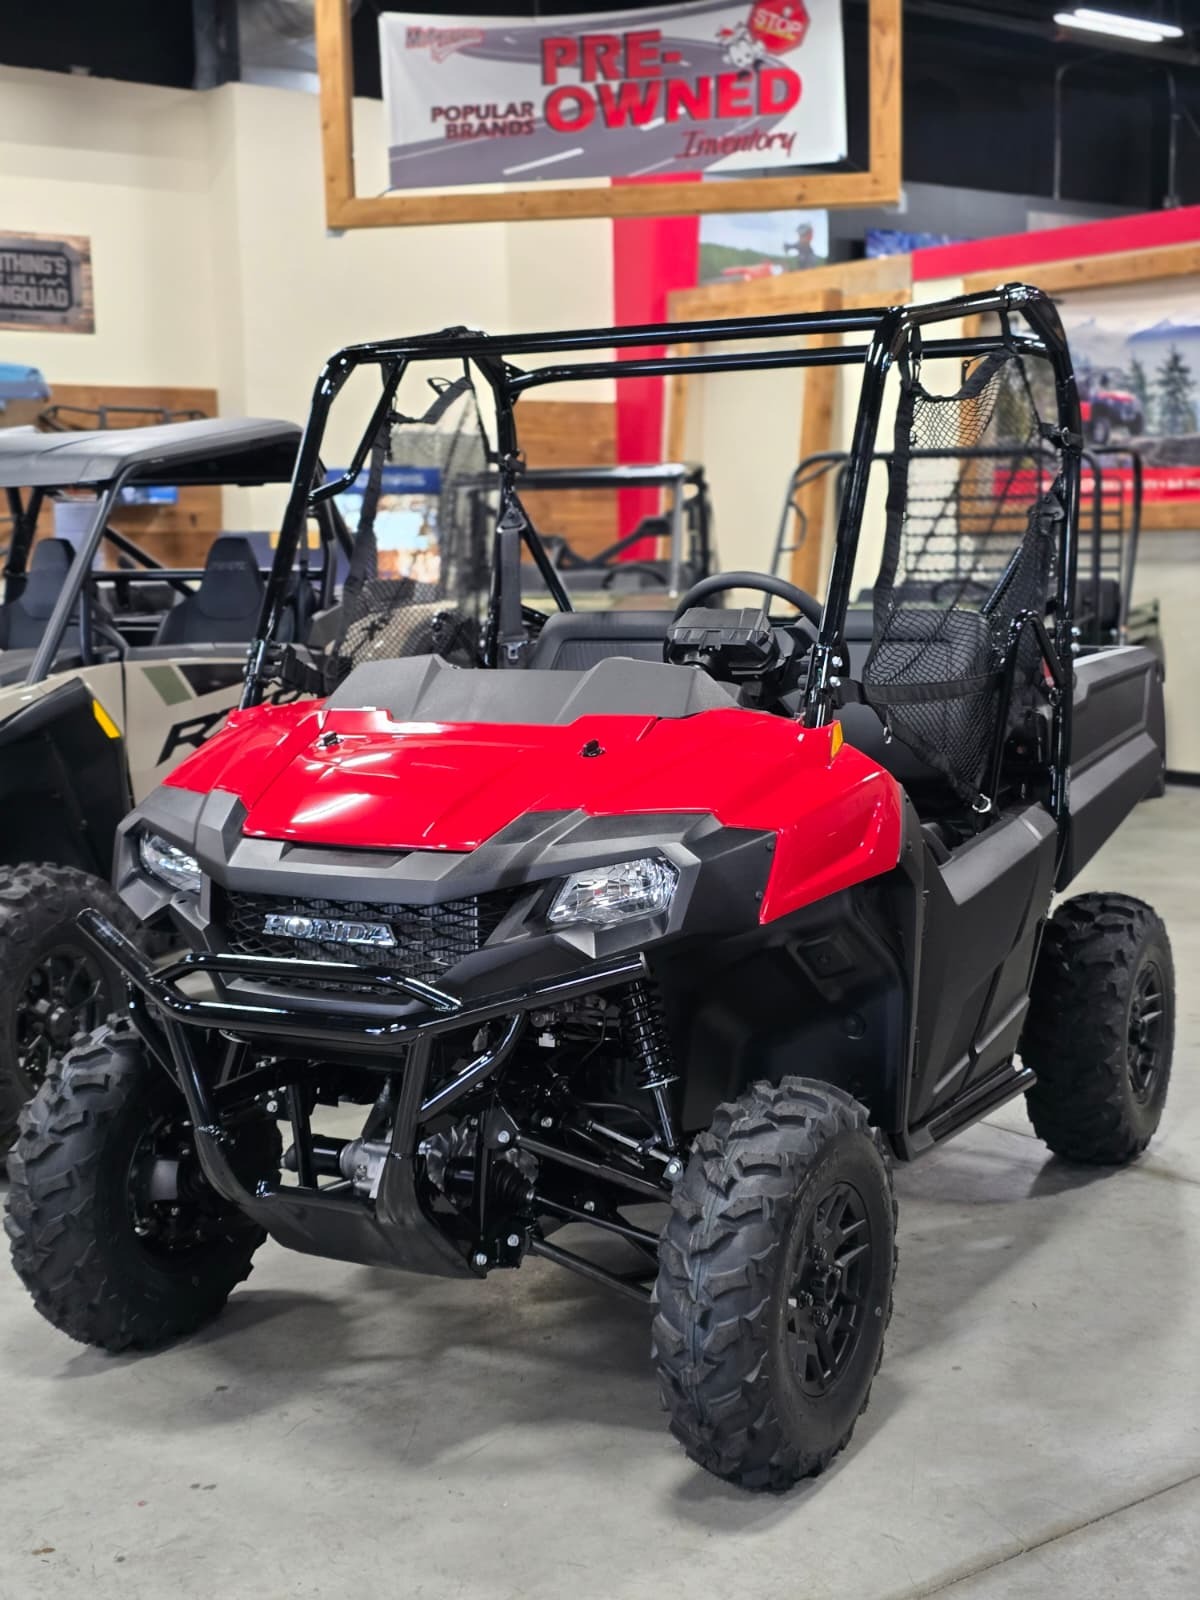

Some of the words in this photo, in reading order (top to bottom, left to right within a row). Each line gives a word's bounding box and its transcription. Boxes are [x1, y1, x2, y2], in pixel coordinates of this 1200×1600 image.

[753, 7, 803, 33] STOP
[541, 30, 682, 86] PRE-
[431, 101, 534, 122] POPULAR
[543, 67, 802, 133] OWNED
[445, 119, 535, 139] BRANDS
[674, 129, 797, 159] Inventory
[262, 914, 397, 946] HONDA
